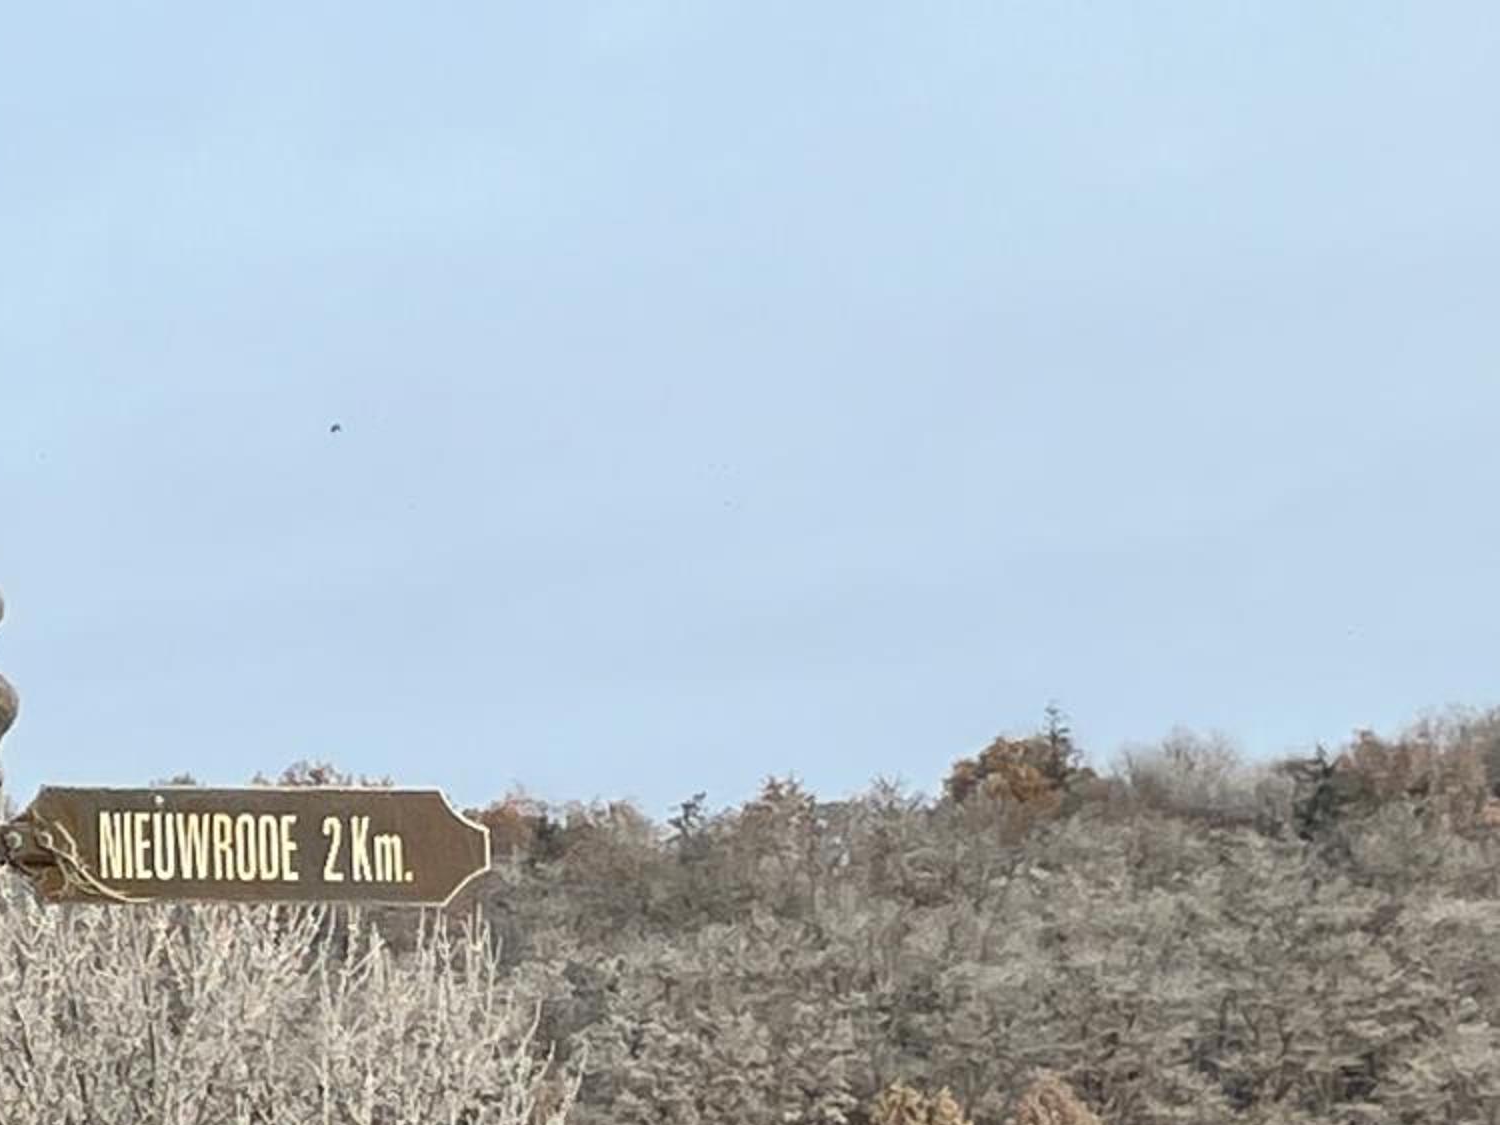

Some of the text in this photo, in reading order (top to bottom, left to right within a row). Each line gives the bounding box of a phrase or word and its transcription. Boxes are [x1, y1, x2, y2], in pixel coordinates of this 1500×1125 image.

[98, 811, 414, 882] NIEUWRODE 2 Km.
